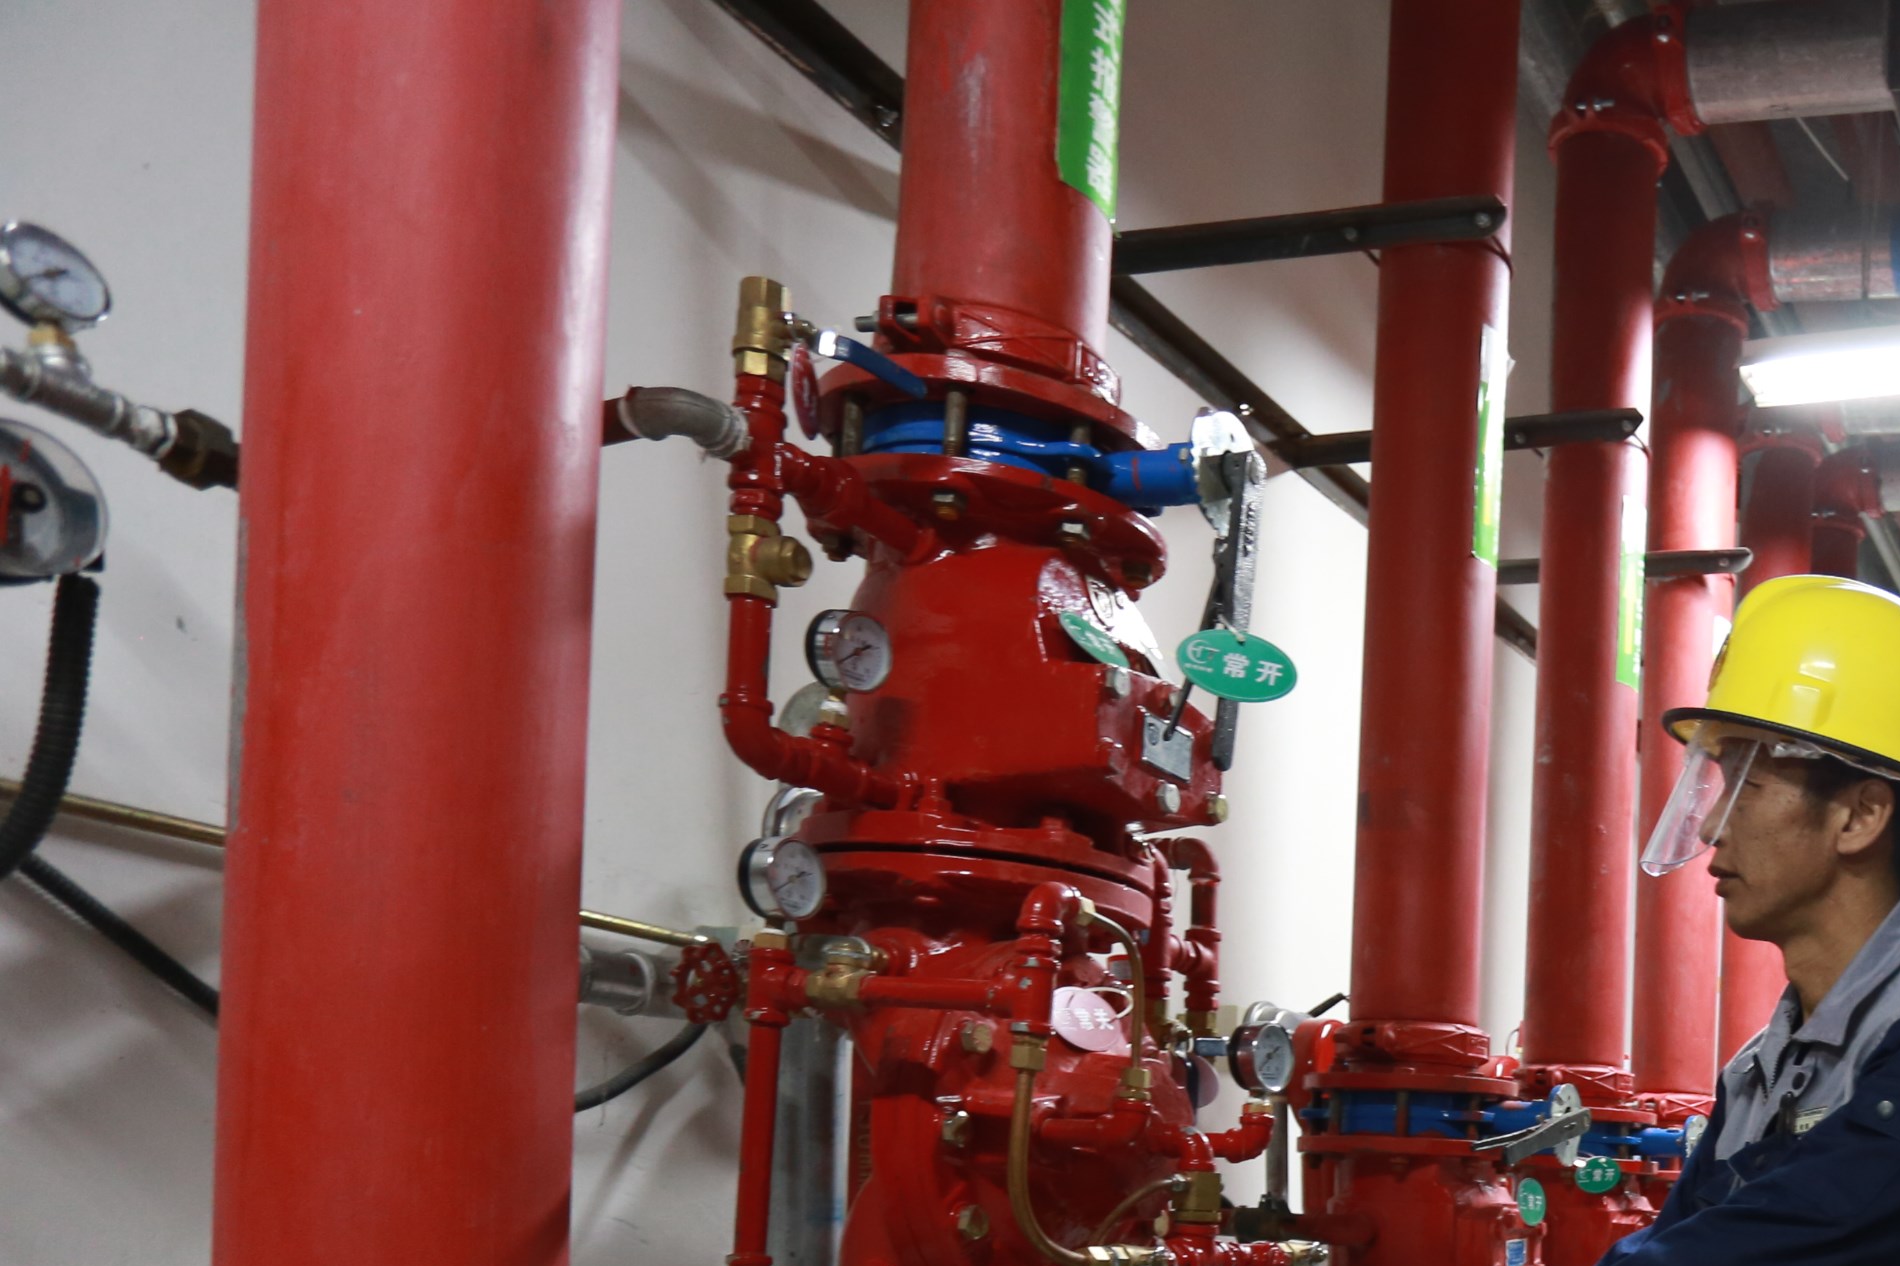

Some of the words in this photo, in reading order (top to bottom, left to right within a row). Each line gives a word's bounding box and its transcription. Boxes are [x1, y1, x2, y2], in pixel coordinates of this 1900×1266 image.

[1086, 0, 1126, 206] 式报警器
[1222, 651, 1284, 687] 常开
